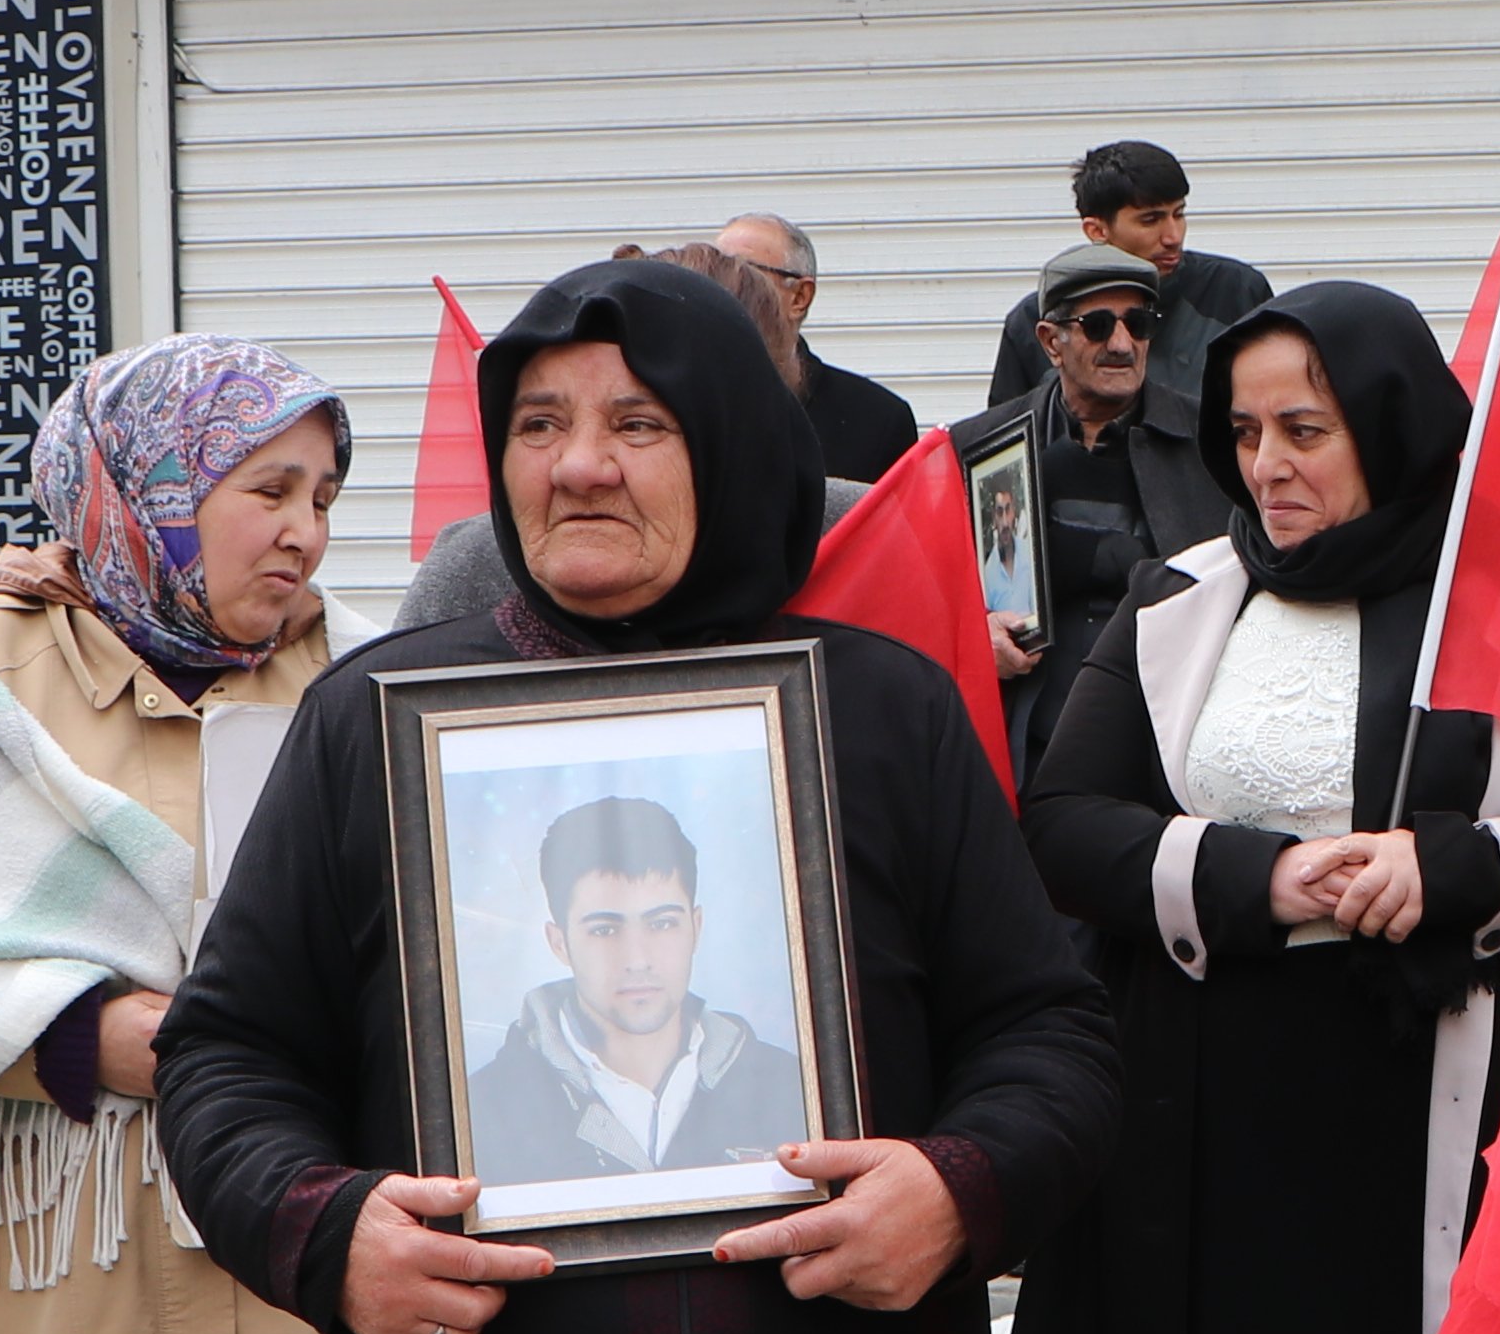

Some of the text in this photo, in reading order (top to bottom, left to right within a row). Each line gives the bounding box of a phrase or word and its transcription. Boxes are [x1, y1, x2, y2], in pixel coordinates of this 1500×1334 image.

[18, 72, 50, 205] COFFEE
[54, 6, 96, 202] LOVREN
[39, 262, 65, 378] LOVREN
